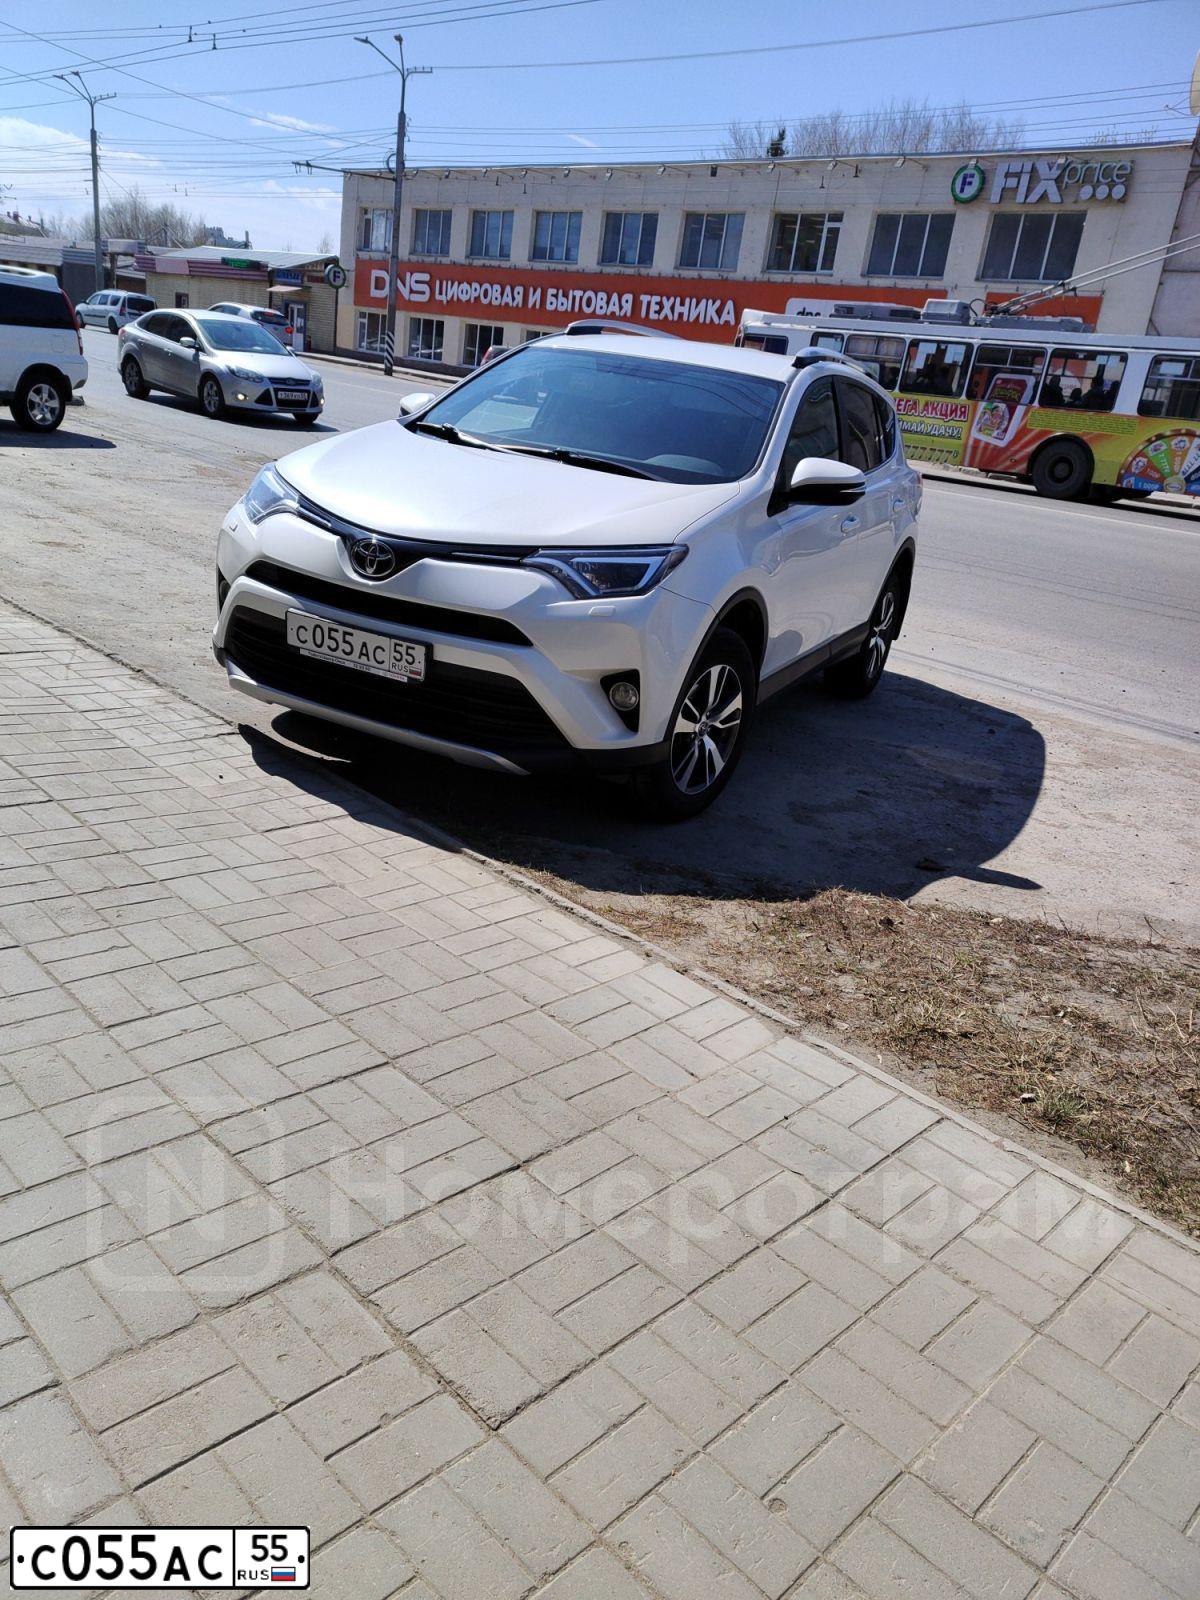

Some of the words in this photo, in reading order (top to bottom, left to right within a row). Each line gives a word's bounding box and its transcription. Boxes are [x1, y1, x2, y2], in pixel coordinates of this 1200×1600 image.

[1062, 160, 1133, 189] price
[370, 269, 431, 302] DNS
[435, 280, 524, 308] ЦИФРОВАЯ
[527, 287, 542, 310] И
[546, 287, 634, 317] БЫТОВАЯ
[639, 294, 736, 326] ТЕХНИКА
[920, 400, 969, 422] АКЦИЯ
[925, 422, 962, 439] УДАЧУ!
[392, 642, 416, 666] 55
[391, 661, 409, 673] RUS
